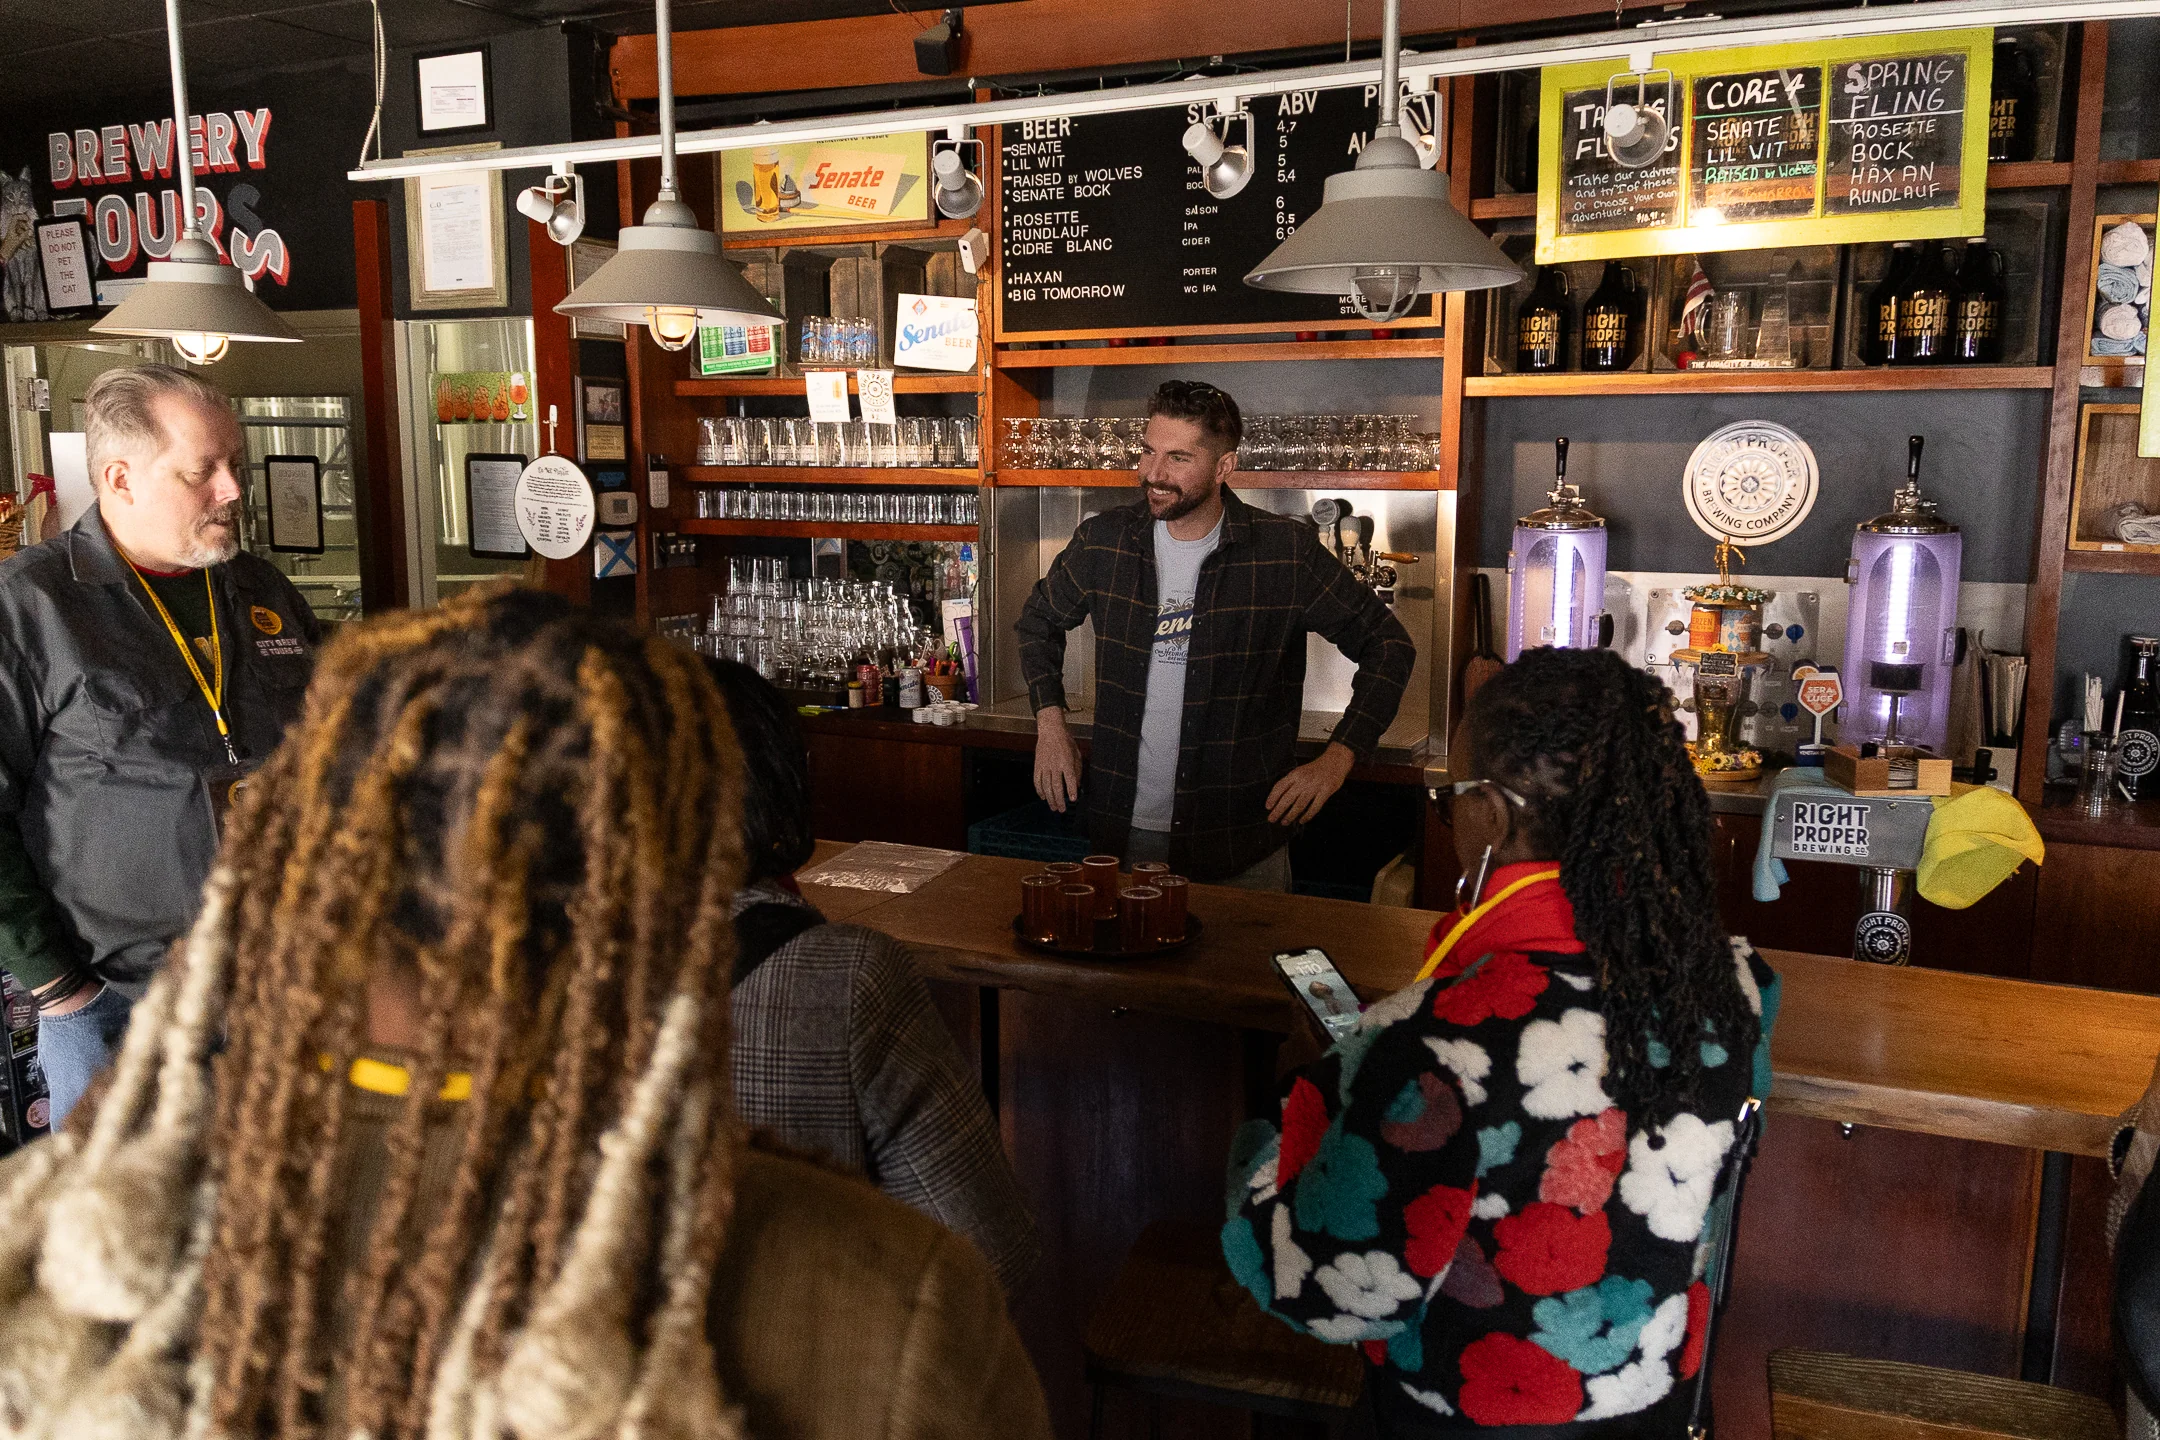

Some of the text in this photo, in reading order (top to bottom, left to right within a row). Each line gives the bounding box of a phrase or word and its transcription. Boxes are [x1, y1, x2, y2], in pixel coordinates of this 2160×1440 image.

[1843, 60, 1955, 94] SPRING
[1706, 73, 1806, 110] CORE 4
[1277, 90, 1319, 117] ABV
[1850, 88, 1945, 119] FLING
[1022, 116, 1072, 141] BEER
[1706, 116, 1783, 141] SENATE
[1852, 118, 1938, 140] ROSETTE
[48, 107, 273, 191] BREWERY
[1010, 140, 1063, 157] SENATE
[1011, 135, 1288, 172] LIL WIT 5
[1707, 140, 1788, 164] LIL WIT
[1851, 142, 1914, 163] BOCK
[808, 162, 885, 190] Senate
[1012, 172, 1063, 189] RAISED
[1067, 174, 1079, 185] BY
[1084, 165, 1144, 184] WOLVES
[1277, 153, 1287, 168] 5
[1574, 173, 1610, 187] Take
[1704, 166, 1759, 185] RAISED
[847, 194, 878, 210] BEER
[1012, 187, 1065, 203] SENATE
[1074, 183, 1112, 199] BOCK
[1186, 181, 1205, 191] BOC
[1575, 188, 1597, 199] and
[1849, 182, 1941, 207] RUNDLAUF
[1012, 195, 1285, 228] ROSETTE SAISON 6
[1571, 206, 1627, 223] adventure!
[46, 227, 75, 238] PLEASE
[1012, 224, 1090, 242] RUNDLAUF
[1183, 221, 1199, 232] IPA
[49, 241, 77, 254] DO NOT
[1011, 241, 1054, 257] CIDRE
[1066, 237, 1114, 254] BLANC
[1181, 236, 1211, 247] CIDER
[57, 256, 72, 267] PET
[60, 270, 75, 281] THE
[1013, 266, 1218, 286] HAXAN PORTER
[61, 283, 77, 294] CAT
[1012, 284, 1218, 302] BIG TOMORROW WC IPA
[1901, 298, 1950, 316] RIGHT
[899, 311, 974, 351] Senate
[1520, 315, 1561, 331] RIGHT
[1585, 313, 1628, 329] RIGHT
[1901, 315, 1950, 331] PROPER
[944, 336, 973, 348] BEER
[1585, 328, 1627, 342] PROPER
[1691, 361, 1705, 369] THE
[1701, 432, 1801, 479] RIGHT PROPER
[1702, 489, 1797, 531] BREWING COMPANY
[255, 640, 275, 648] CITY
[1807, 686, 1833, 694] SERA
[1807, 694, 1834, 703] LUCE
[1794, 803, 1869, 827] RIGHT
[1794, 825, 1868, 846] PROPER
[1793, 843, 1852, 855] BREWING
[1859, 916, 1909, 945] RIGHT PROPER
